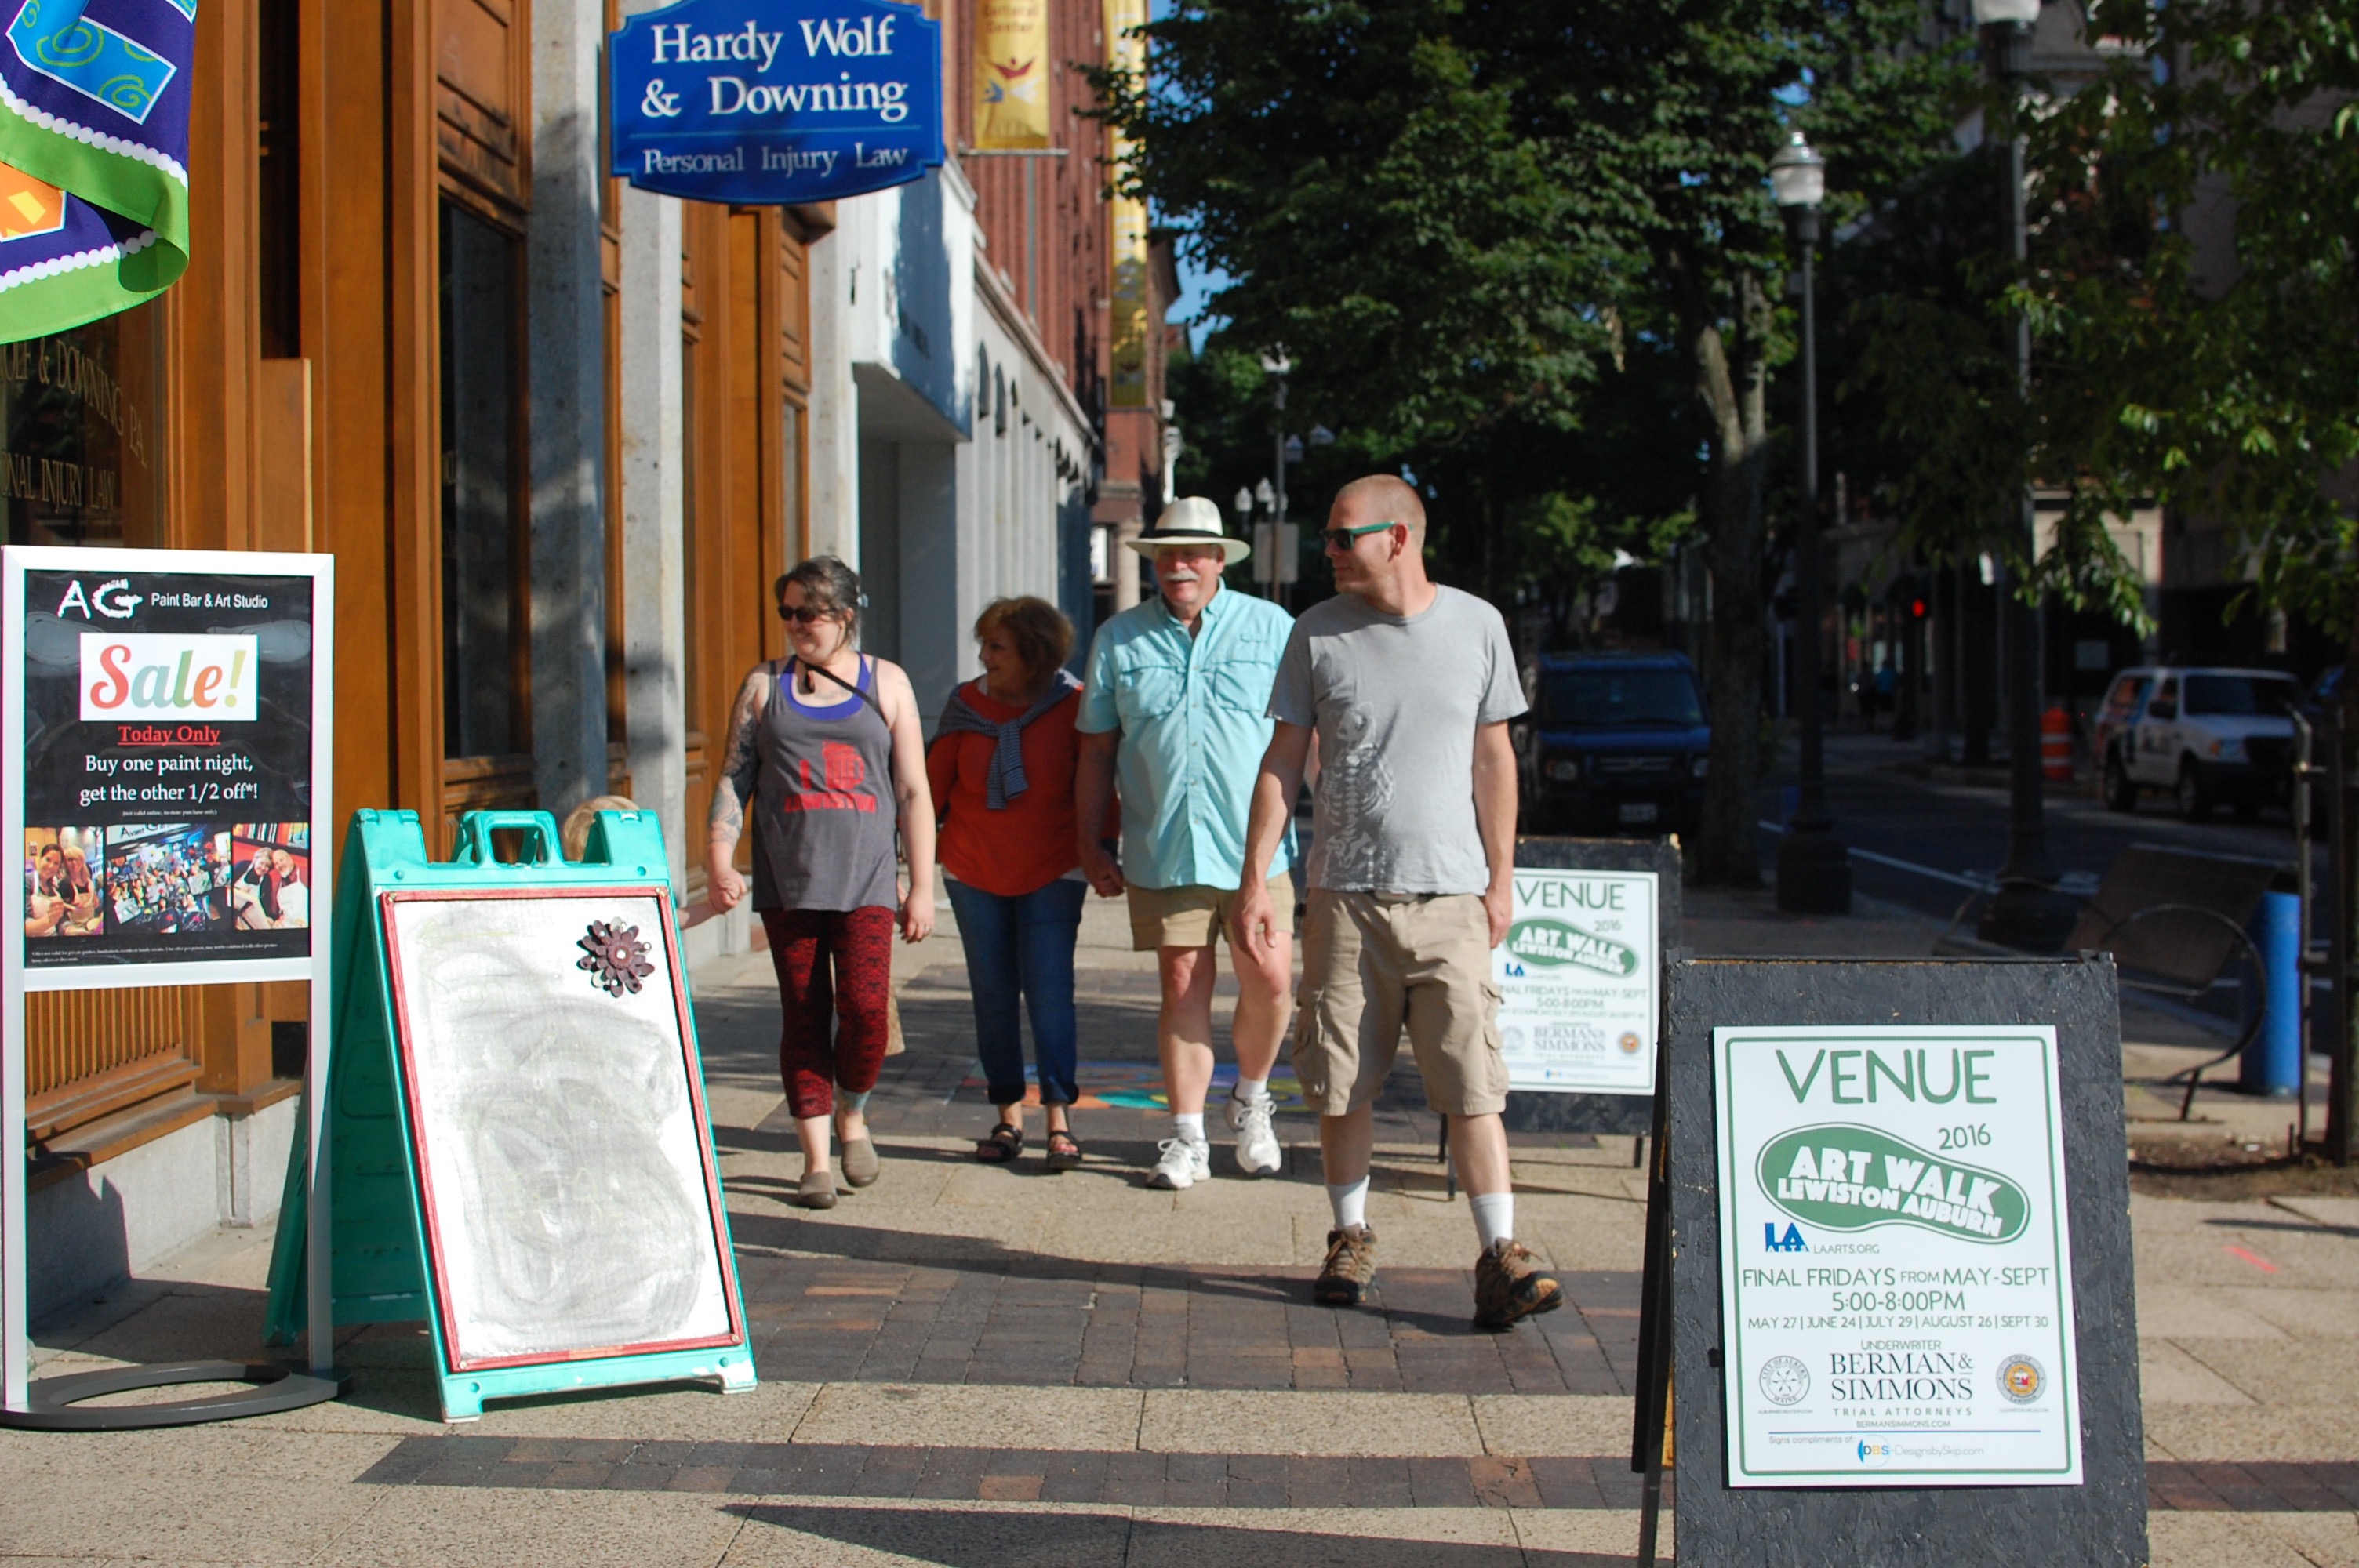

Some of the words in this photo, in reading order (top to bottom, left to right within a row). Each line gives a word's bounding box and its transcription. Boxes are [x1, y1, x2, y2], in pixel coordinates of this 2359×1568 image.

[652, 20, 783, 73] Hardy
[799, 13, 896, 57] Wolf
[641, 79, 682, 118] &
[708, 71, 910, 122] Downing
[642, 147, 745, 175] Personal
[761, 145, 839, 178] Injury
[855, 142, 909, 169] Law
[56, 339, 124, 436] DOWNING
[42, 458, 84, 514] INJURY
[90, 466, 115, 510] LAW
[57, 578, 144, 620] AG
[151, 592, 180, 608] Paint
[182, 593, 202, 608] Bar
[204, 593, 213, 608] &
[214, 593, 231, 608] Art
[233, 593, 269, 609] Studio
[90, 644, 247, 710] Sale!
[118, 724, 173, 746] Today
[176, 724, 221, 746] Only
[85, 754, 118, 777] Buy
[122, 758, 154, 771] one
[158, 754, 202, 776] paint
[205, 753, 254, 776] night,
[79, 786, 107, 807] get
[111, 783, 136, 801] the
[141, 784, 186, 801] other
[188, 782, 220, 804] 1/2
[1515, 880, 1626, 910] VENUE
[1518, 925, 1562, 946] ART
[1566, 931, 1627, 965] WALK
[1776, 1048, 1997, 1104] VENUE
[1937, 1123, 1992, 1151] 2016
[1788, 1145, 1872, 1184] ART
[1884, 1154, 2001, 1215] WALK
[1776, 1178, 1902, 1212] LEWISTON
[1900, 1193, 2003, 1239] AUBURN
[1765, 1222, 1809, 1252] LA
[1813, 1244, 1880, 1254] LAARTS.ORG
[1743, 1269, 1802, 1287] FINAL
[1807, 1267, 1896, 1287] FRIDAYS
[1900, 1271, 1940, 1283] FROM
[1943, 1267, 2050, 1287] MAY-SEPT
[1832, 1290, 1966, 1312] 5:00-8:00PM
[1748, 1317, 1779, 1329] MAY
[1783, 1317, 1797, 1328] 27
[1807, 1316, 1837, 1328] JUNE
[1841, 1316, 1856, 1328] 24
[1866, 1316, 1895, 1328] JULY
[1898, 1316, 1913, 1328] 29
[1921, 1316, 1974, 1328] AUGUST
[1978, 1316, 1992, 1327] 26
[2001, 1316, 2031, 1328] SEPT
[2034, 1316, 2048, 1327] 30
[1860, 1340, 1942, 1351] UNDERWRITER
[1831, 1378, 1973, 1400] SIMMONS
[1834, 1407, 1877, 1416] TRIAL
[1885, 1407, 1972, 1416] ATTORNEYS
[1856, 1420, 1951, 1428] BERMANSIMMONS.COM
[1768, 1436, 1788, 1445] Signs
[1792, 1435, 1843, 1445] compliments
[1863, 1445, 1889, 1456] DBS
